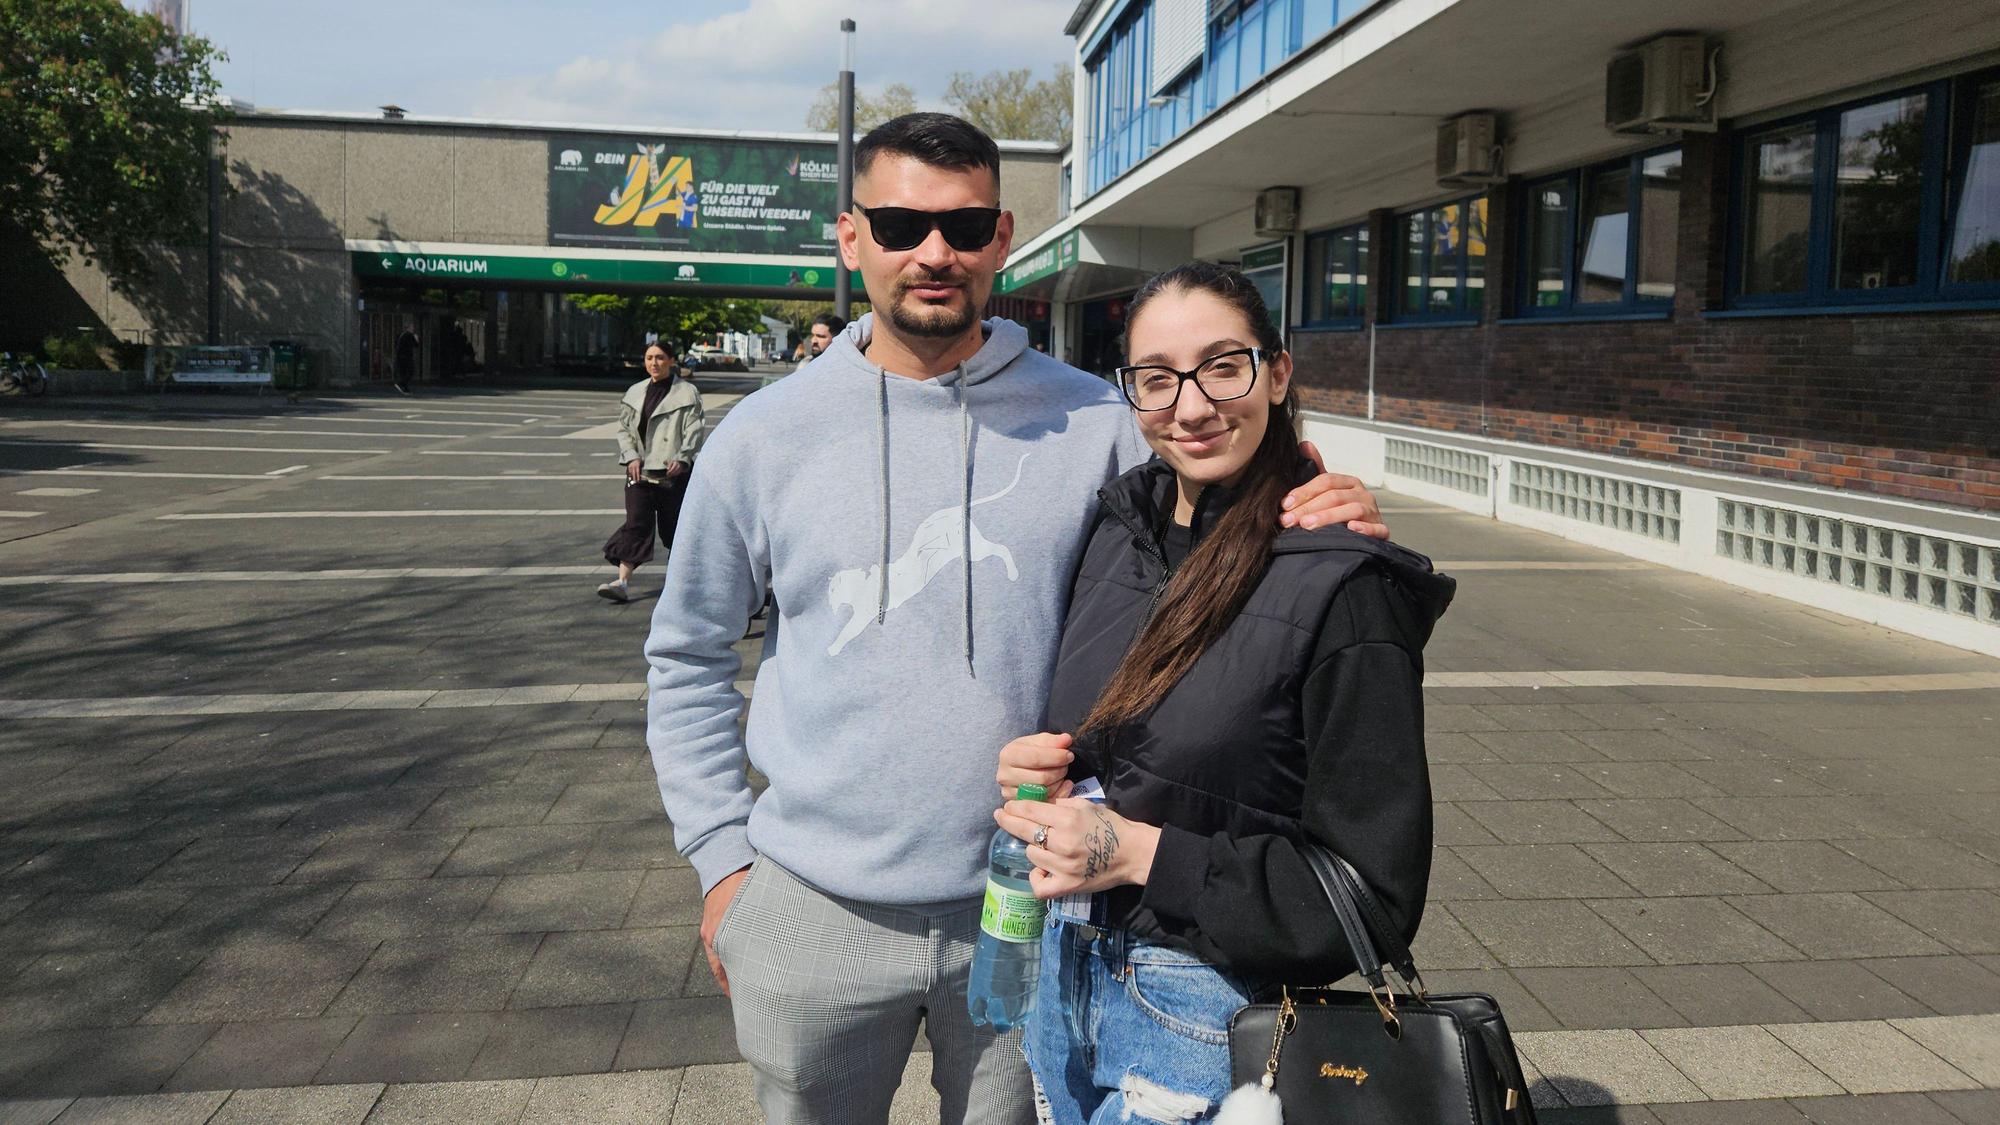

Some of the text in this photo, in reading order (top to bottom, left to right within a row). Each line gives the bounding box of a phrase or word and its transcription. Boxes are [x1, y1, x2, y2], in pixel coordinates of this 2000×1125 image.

[595, 152, 626, 165] DEIN
[800, 160, 830, 172] KÖLN
[700, 181, 779, 196] FÜR DIE WELT
[701, 194, 766, 207] ZU GAST IN
[703, 206, 811, 220] UNSEREN VEEDELN
[405, 257, 488, 273] AQUARIUM
